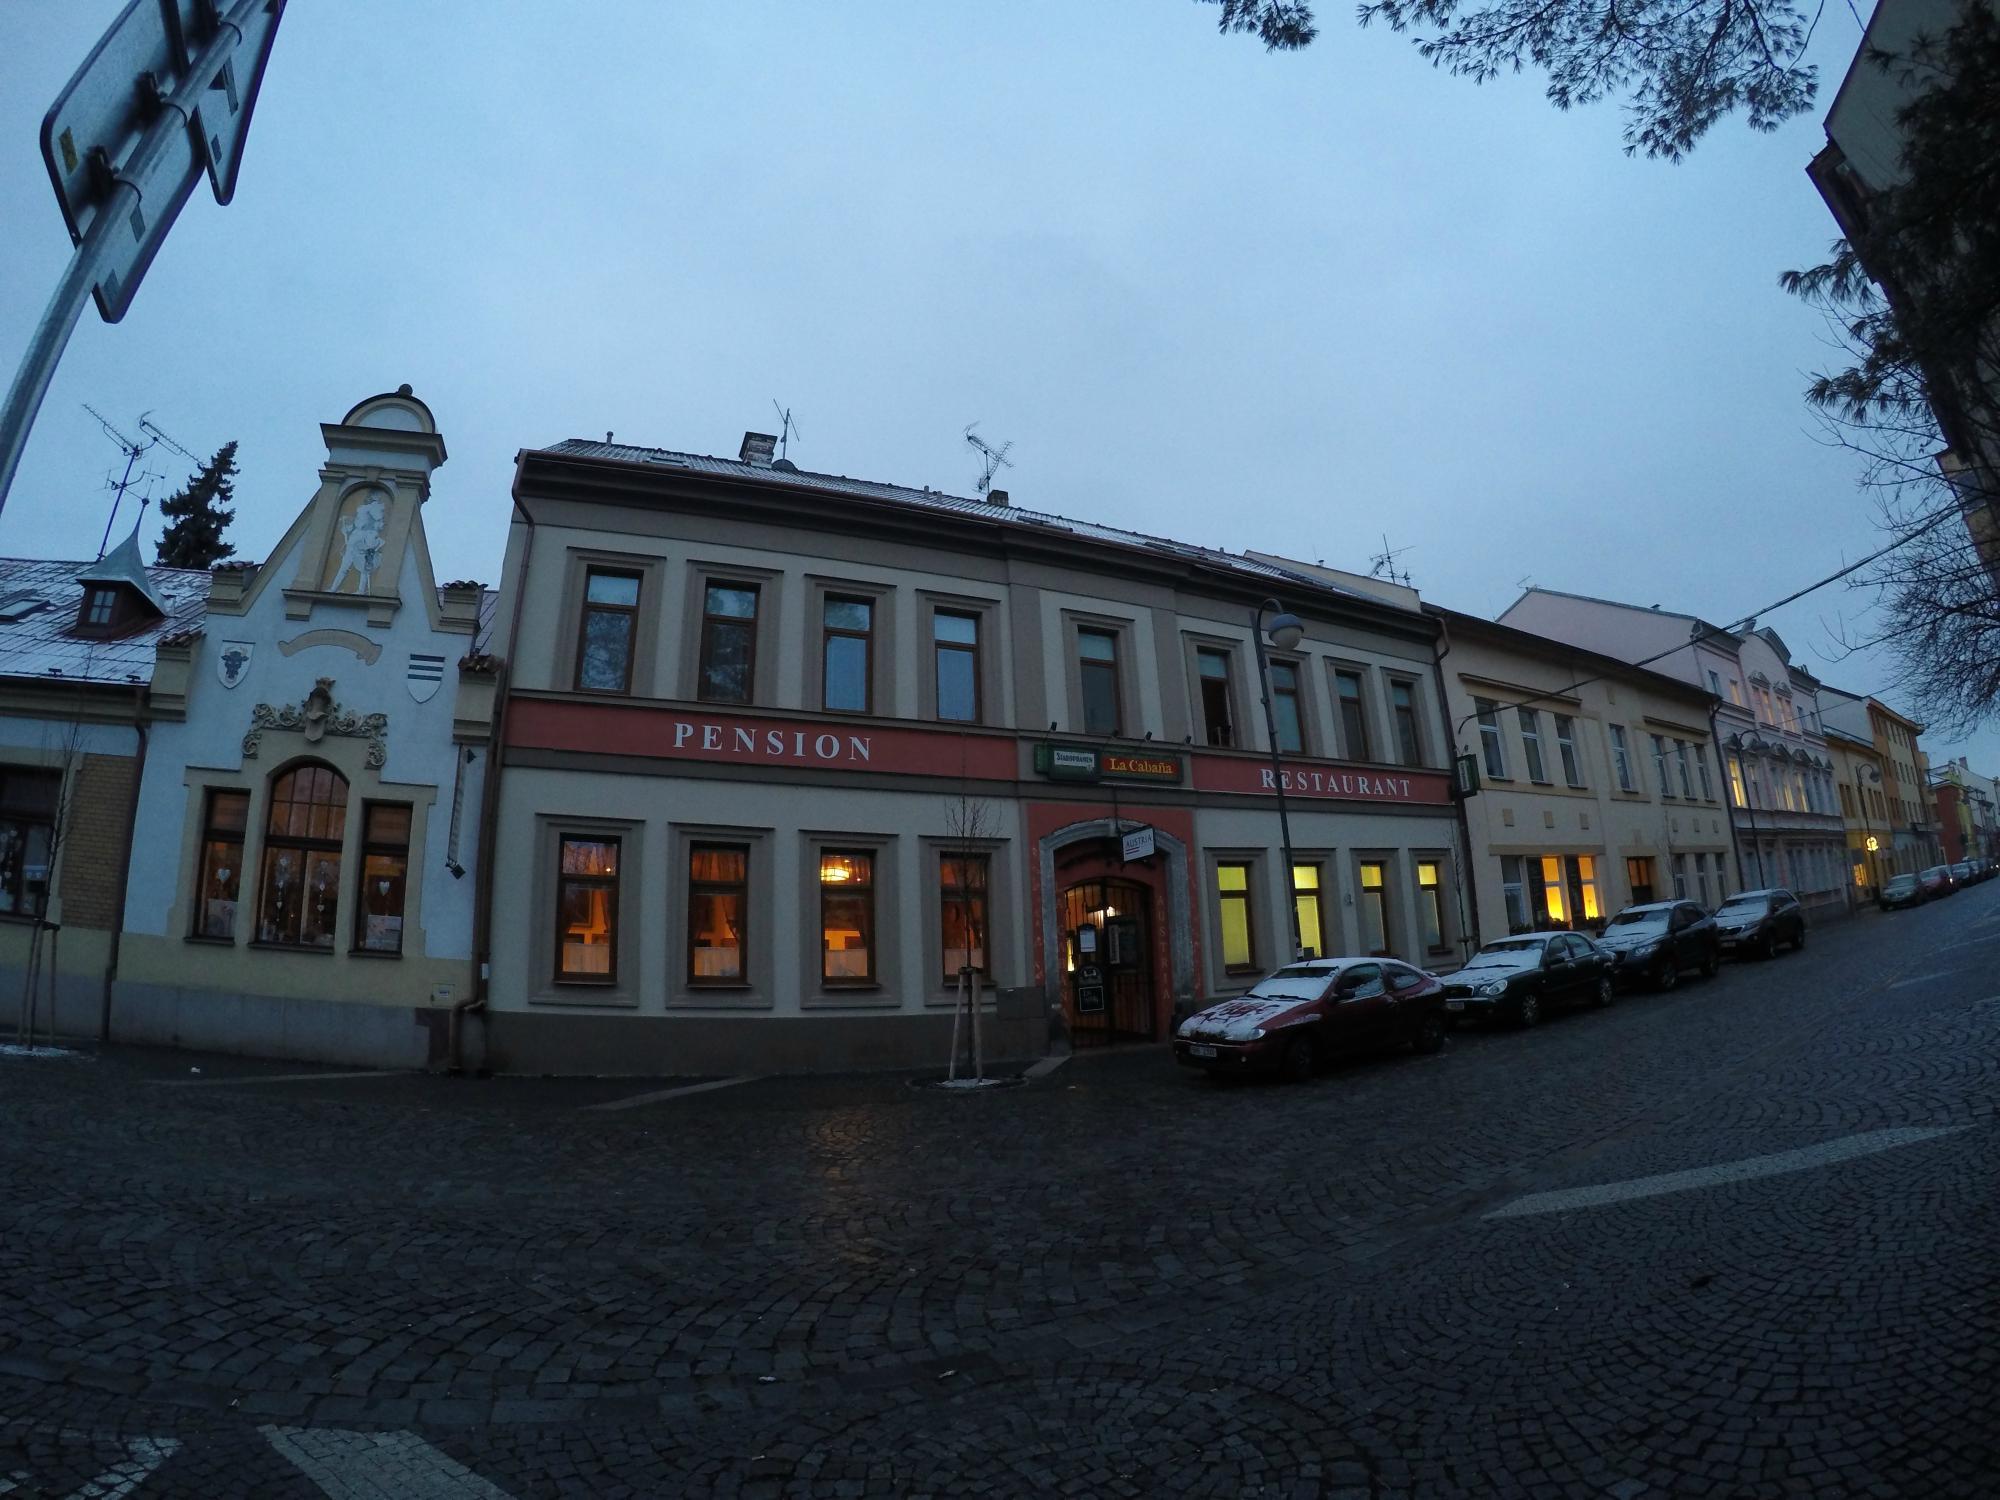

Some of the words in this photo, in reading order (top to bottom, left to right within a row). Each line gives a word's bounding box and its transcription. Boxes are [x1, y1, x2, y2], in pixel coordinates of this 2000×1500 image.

[673, 722, 872, 761] PENSION
[1109, 757, 1127, 771] La
[1129, 759, 1174, 775] Cabaña
[1260, 768, 1411, 797] RESTAURANT
[1126, 834, 1153, 847] AUSTRIA
[1156, 895, 1172, 1000] AUSTRIA
